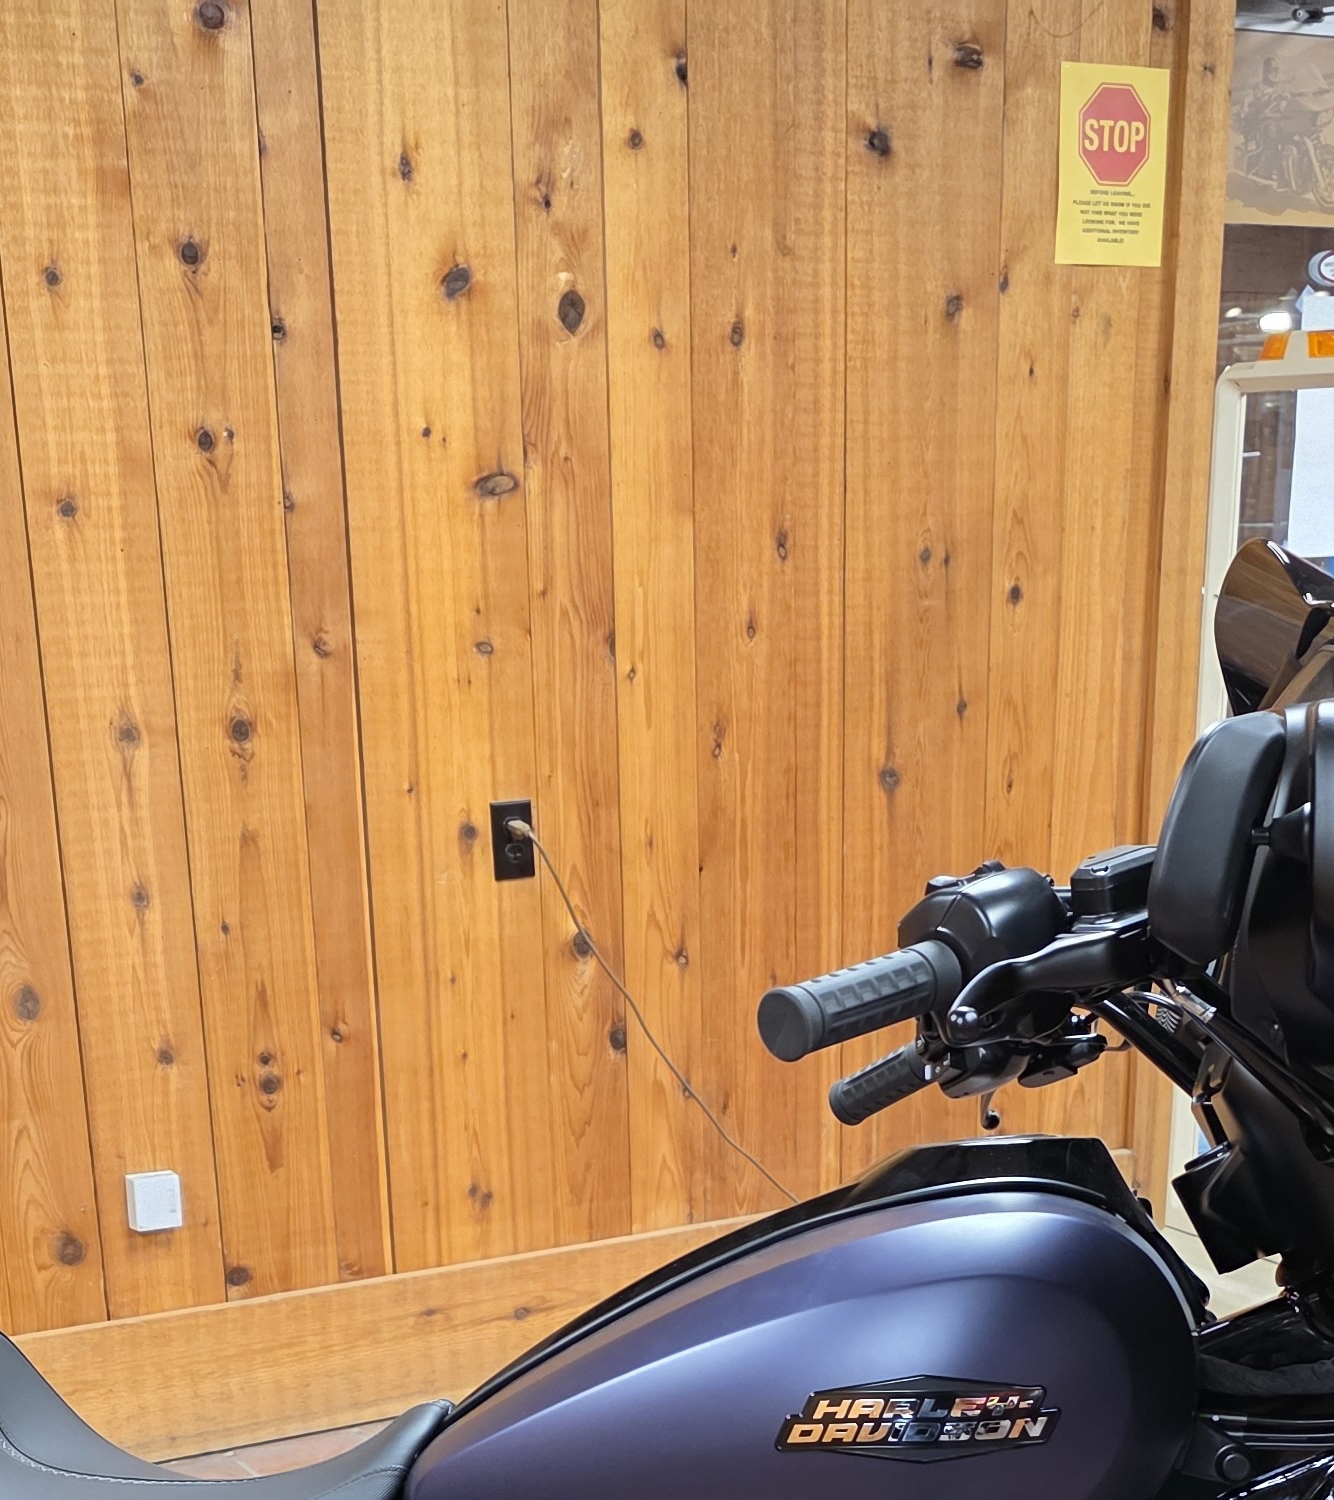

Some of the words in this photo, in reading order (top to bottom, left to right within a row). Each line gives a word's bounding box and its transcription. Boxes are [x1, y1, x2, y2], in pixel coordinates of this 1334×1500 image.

[1084, 118, 1145, 153] STOP
[813, 1395, 1034, 1419] HARLEY-
[786, 1417, 1047, 1443] DAVIDSON
